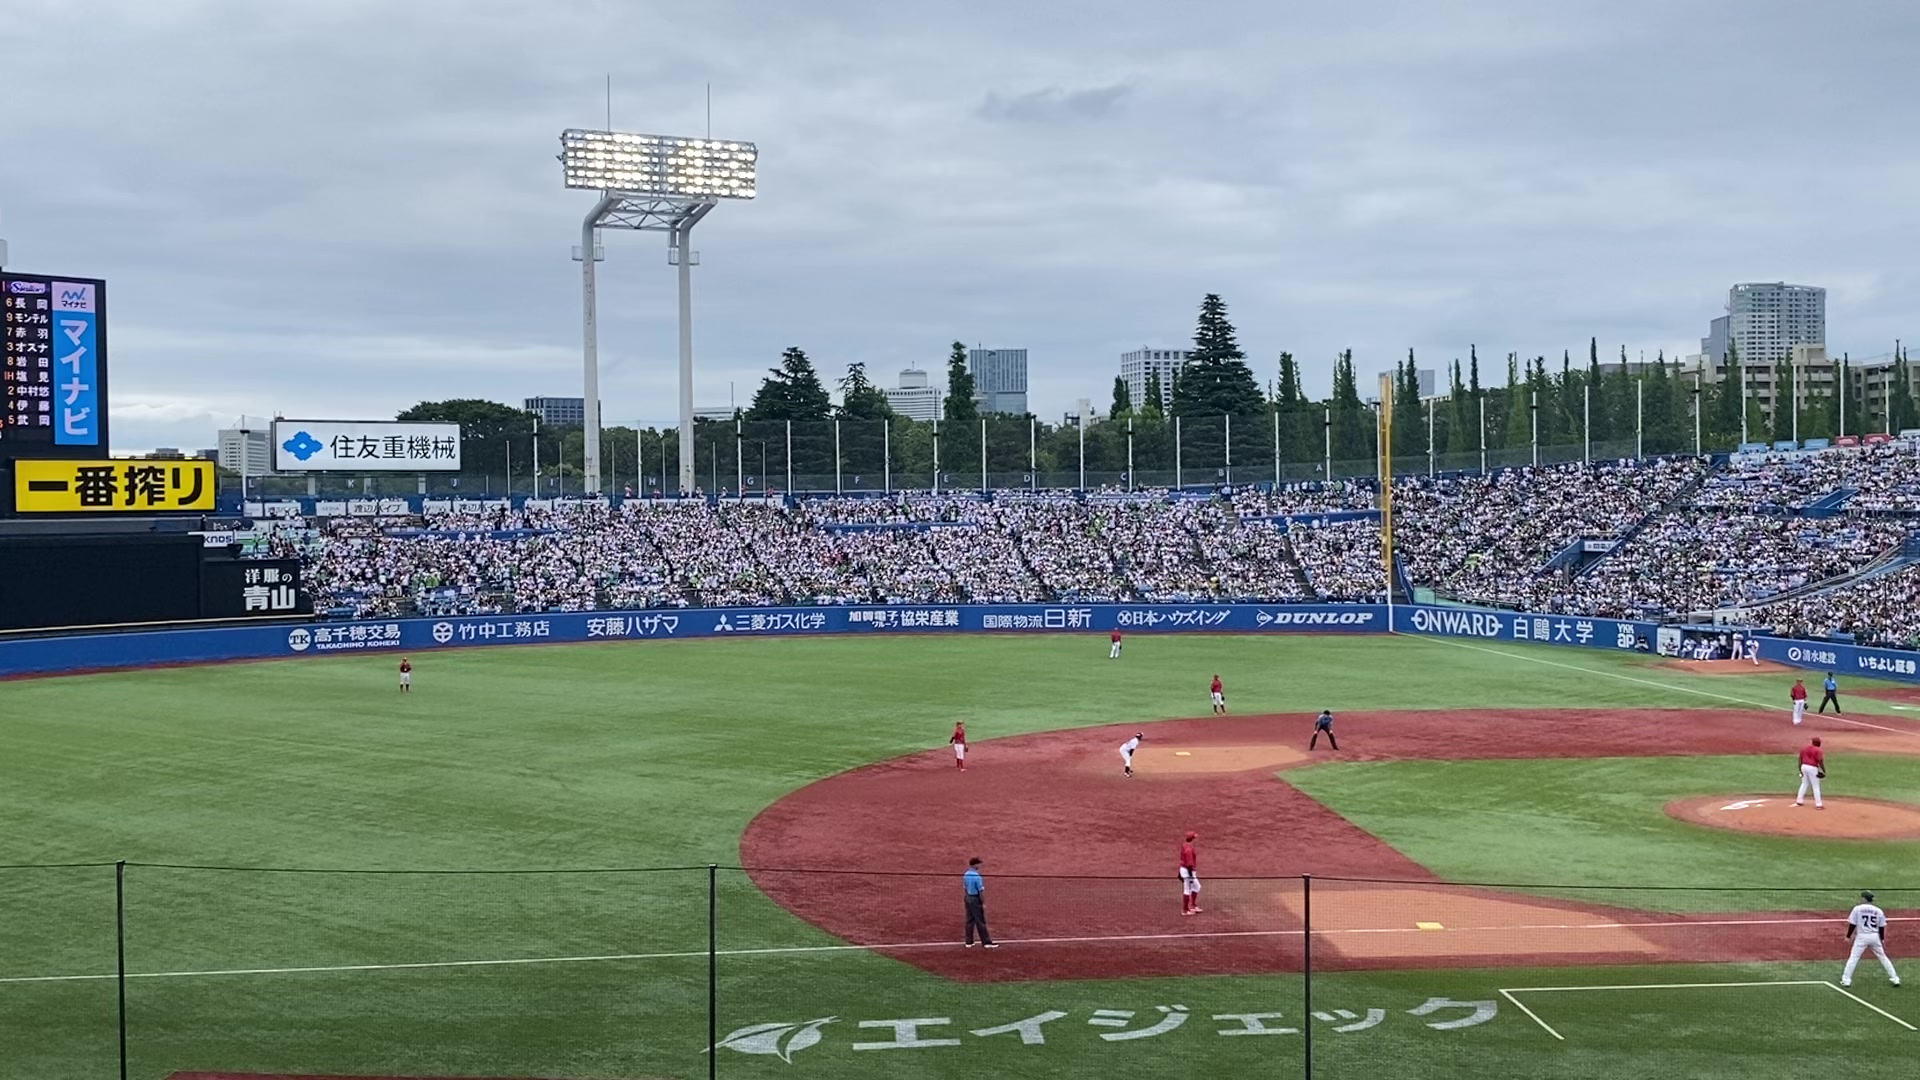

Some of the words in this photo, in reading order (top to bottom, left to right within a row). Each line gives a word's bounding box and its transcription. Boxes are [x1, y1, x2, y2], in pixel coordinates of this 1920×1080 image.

[6, 298, 13, 307] 6
[61, 300, 87, 308] マイナビ
[6, 312, 13, 322] 9
[15, 313, 48, 324] モンテル
[6, 326, 12, 336] 7
[15, 327, 48, 339] 赤羽
[7, 342, 14, 351] 3
[15, 342, 48, 353] オスナ
[7, 357, 14, 366] 8
[16, 356, 49, 367] 岩田
[60, 319, 91, 435] マイナビ
[7, 386, 15, 395] 2
[8, 401, 14, 410] 4
[8, 415, 15, 424] 5
[330, 434, 457, 461] 住友重機械
[29, 466, 204, 507] 一番搾り
[244, 568, 293, 584] 洋服の
[242, 584, 296, 611] 青山
[587, 614, 679, 637] 安藤ハザマ
[735, 613, 826, 631] 三菱ガス化学
[900, 609, 959, 627] 協栄産業
[983, 614, 1043, 628] 国際物流
[1044, 608, 1092, 628] 日新
[1132, 610, 1231, 627] 日本ハウズイング
[1273, 612, 1374, 624] DUNLOP
[1411, 609, 1503, 637] ONWARD
[313, 624, 401, 642] 高千穂交易
[458, 620, 550, 640] 竹中工務店
[316, 641, 365, 650] TAKACHIHO
[367, 639, 400, 647] KOHEKI
[1802, 648, 1837, 665] 清水建設
[1858, 656, 1917, 675] いちよし証券
[1861, 915, 1878, 928] 75
[852, 997, 1499, 1052] エイジェック
